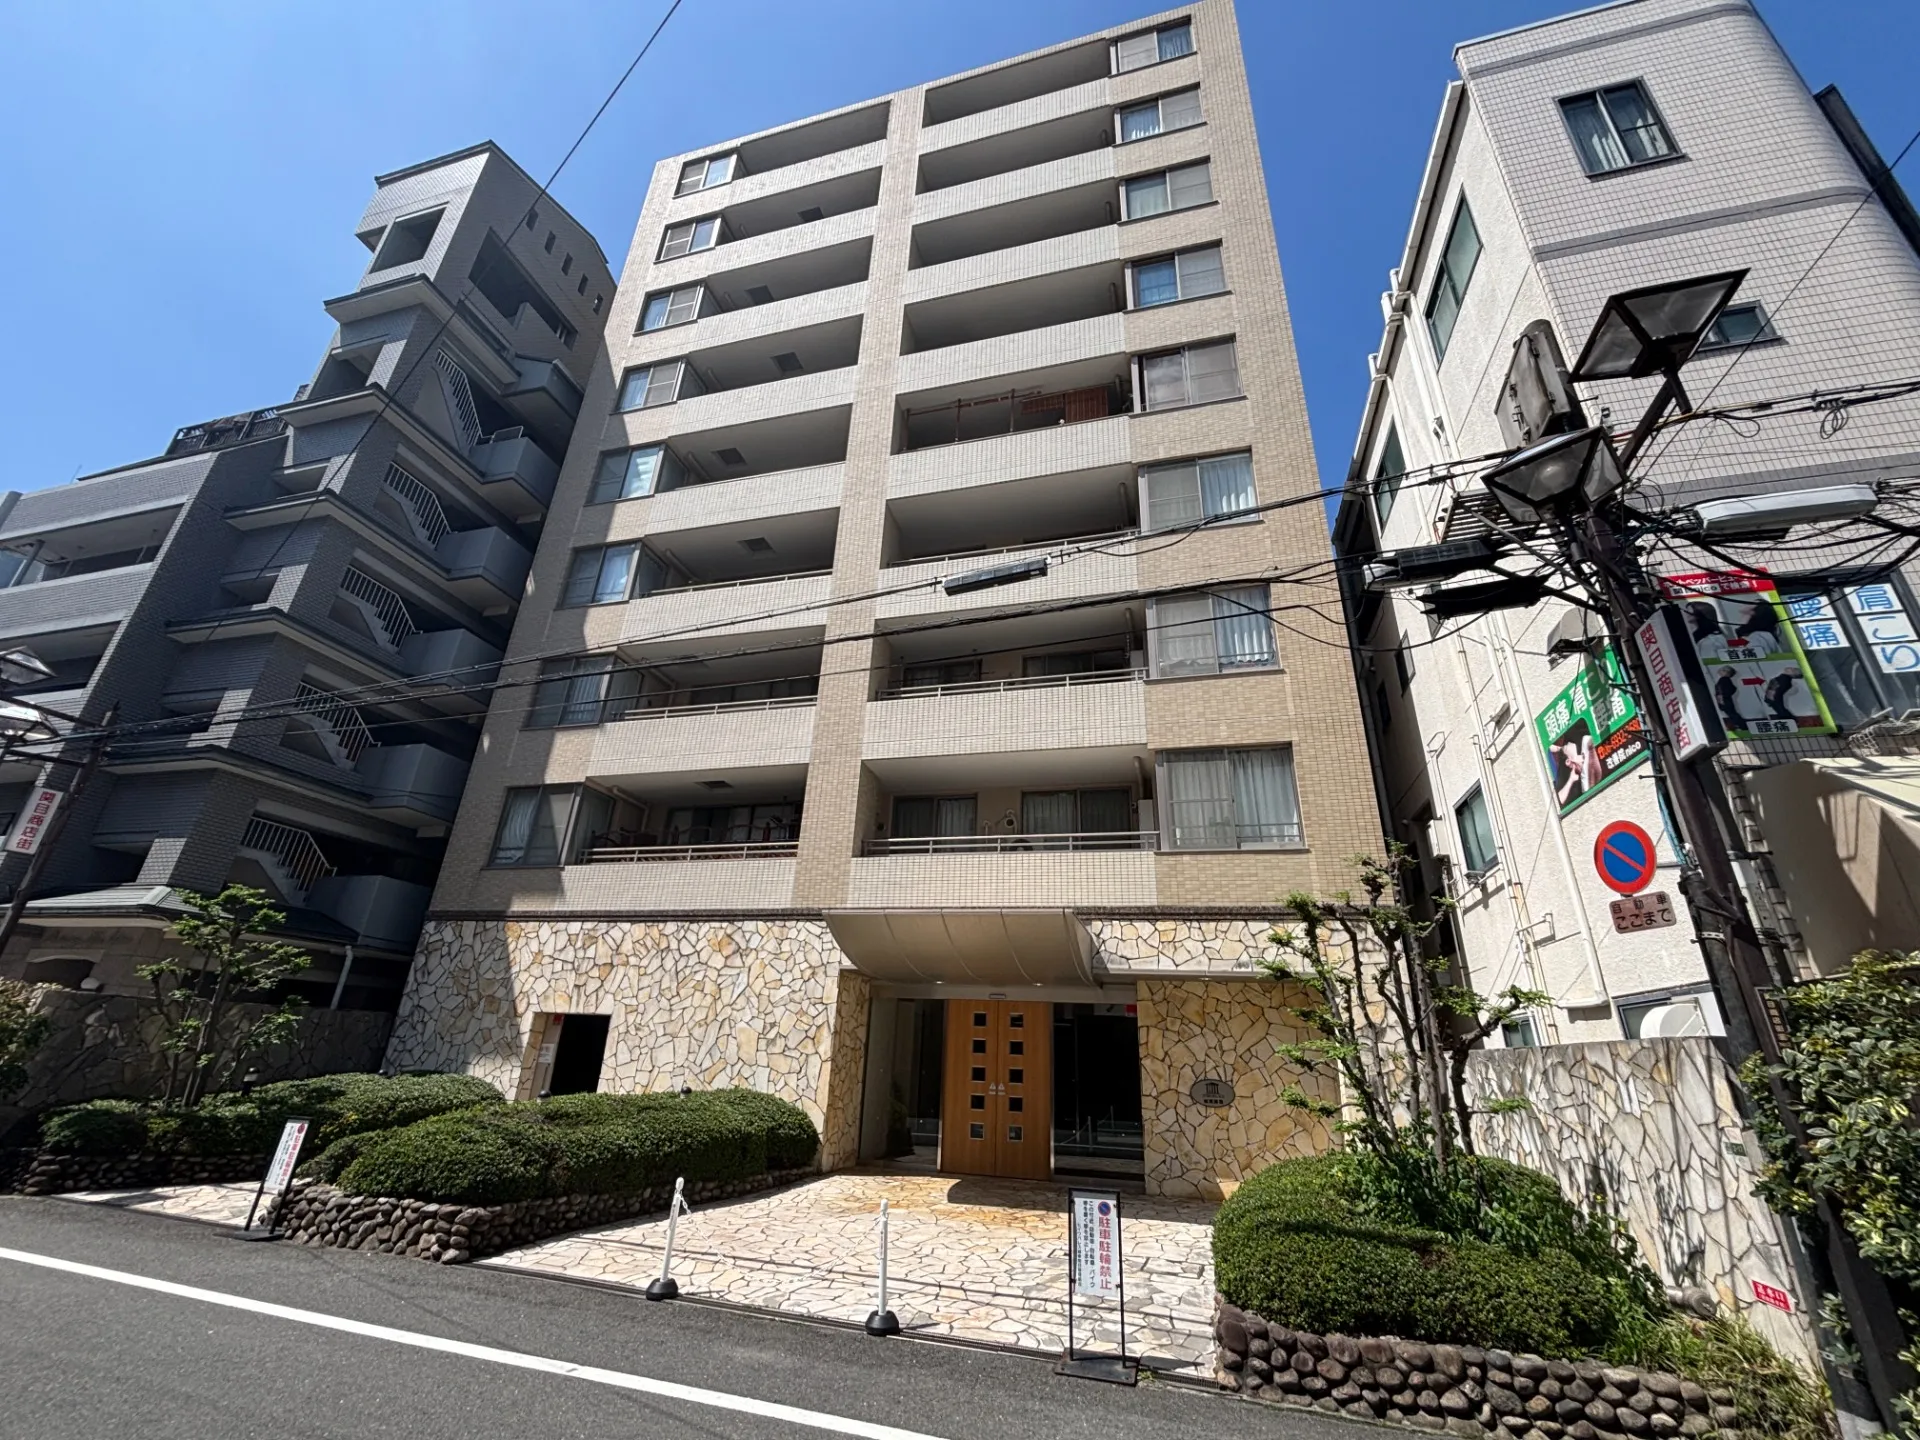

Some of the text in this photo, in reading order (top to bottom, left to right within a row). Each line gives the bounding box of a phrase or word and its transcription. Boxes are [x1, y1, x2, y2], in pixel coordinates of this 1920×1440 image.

[1787, 595, 1840, 647] 腰痛
[1855, 585, 1920, 671] 肩こり
[1543, 698, 1571, 741] 頭痛
[16, 791, 57, 850] 関目商店街
[1612, 893, 1668, 914] 自動車
[1616, 908, 1672, 930] ここまで
[1098, 1216, 1112, 1290] 駐車駐輪禁止
